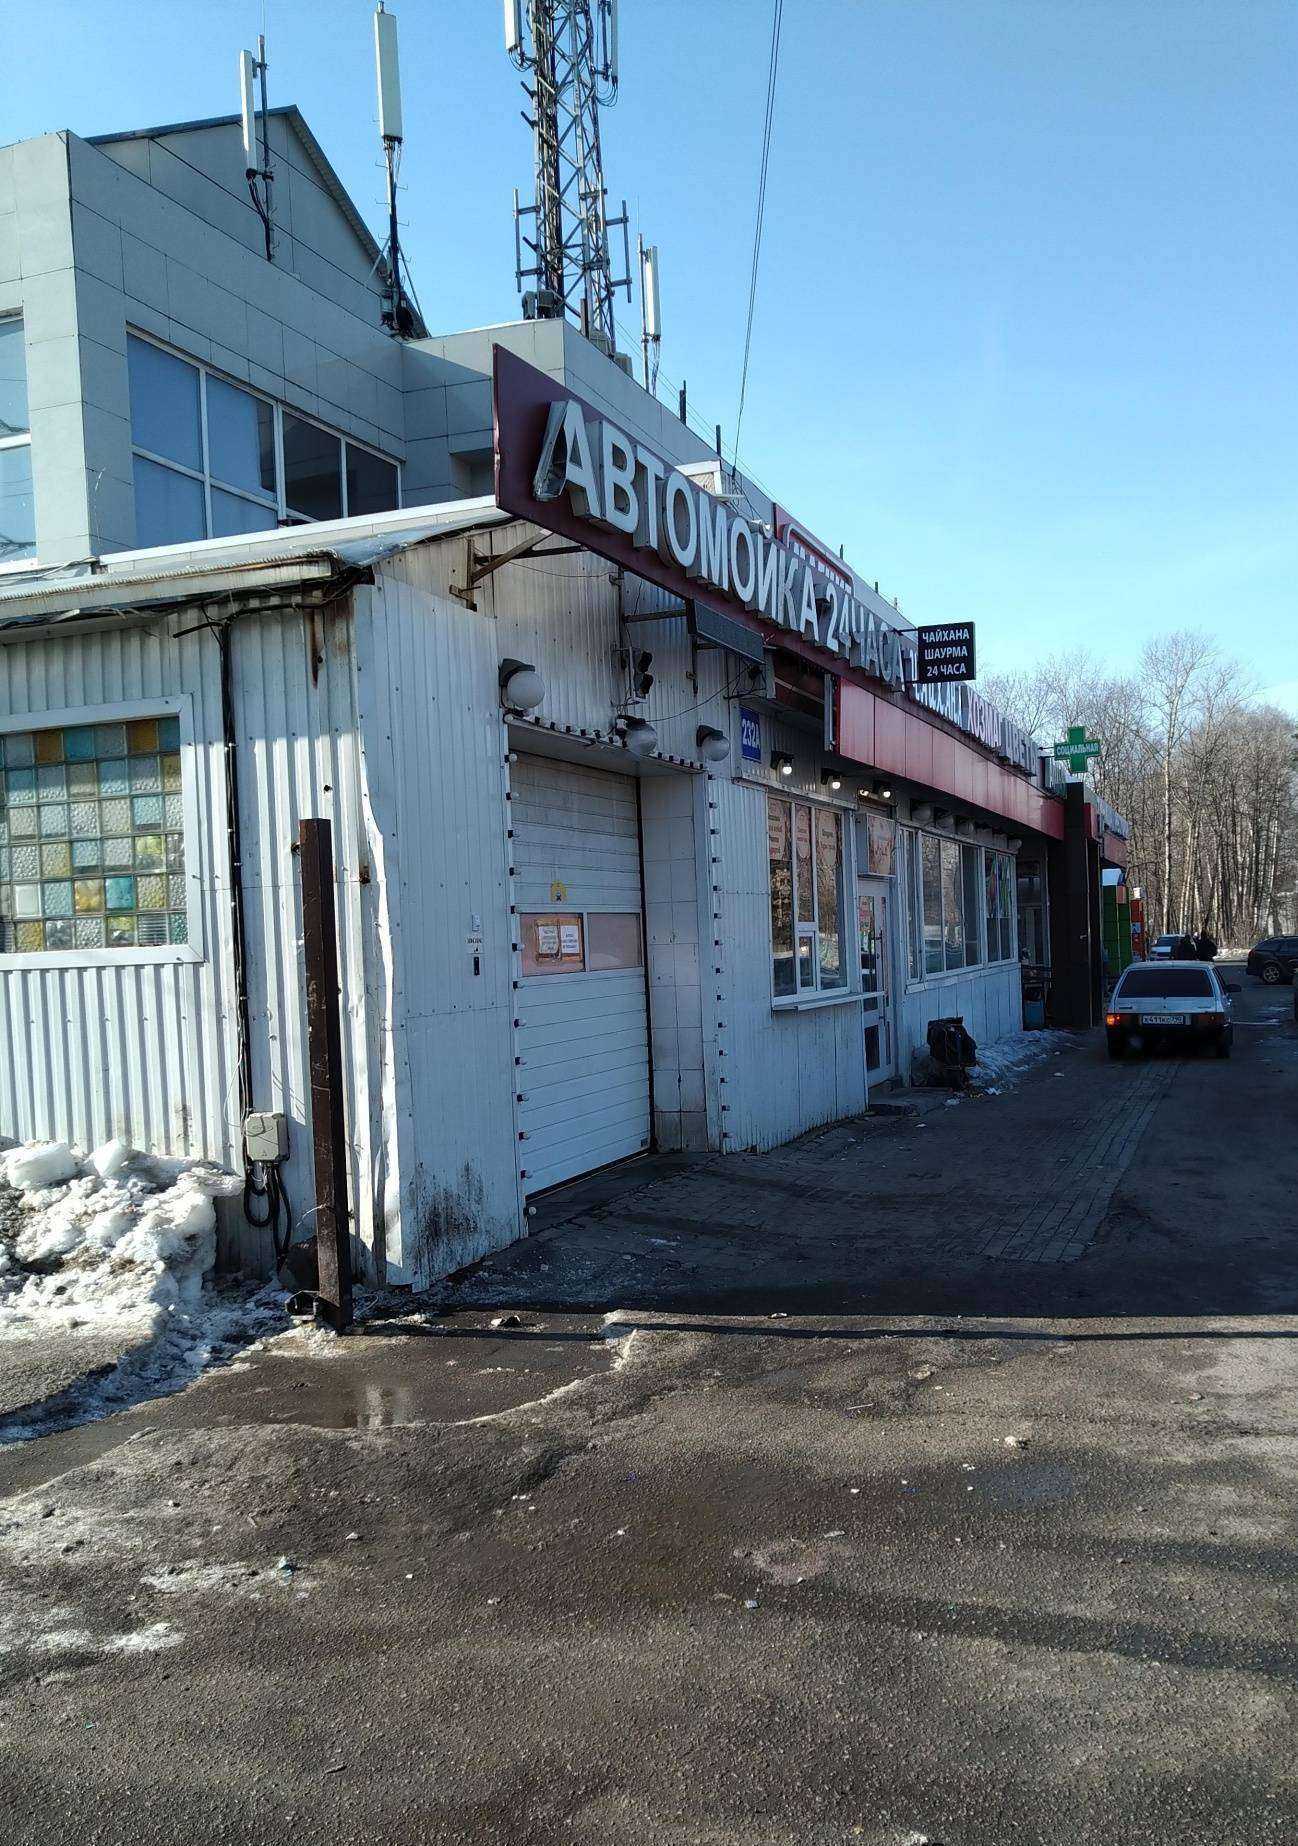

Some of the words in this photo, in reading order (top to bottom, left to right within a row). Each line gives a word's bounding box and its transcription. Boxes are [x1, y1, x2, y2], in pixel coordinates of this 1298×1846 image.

[533, 400, 820, 643] АВТОМОЙКА
[825, 582, 852, 661] 24
[851, 595, 906, 693] ЧАСА
[922, 628, 970, 643] ЧАЙХАНА
[924, 645, 968, 660] ШАУРМА
[927, 666, 939, 677] 24
[940, 663, 967, 676] ЧАСА
